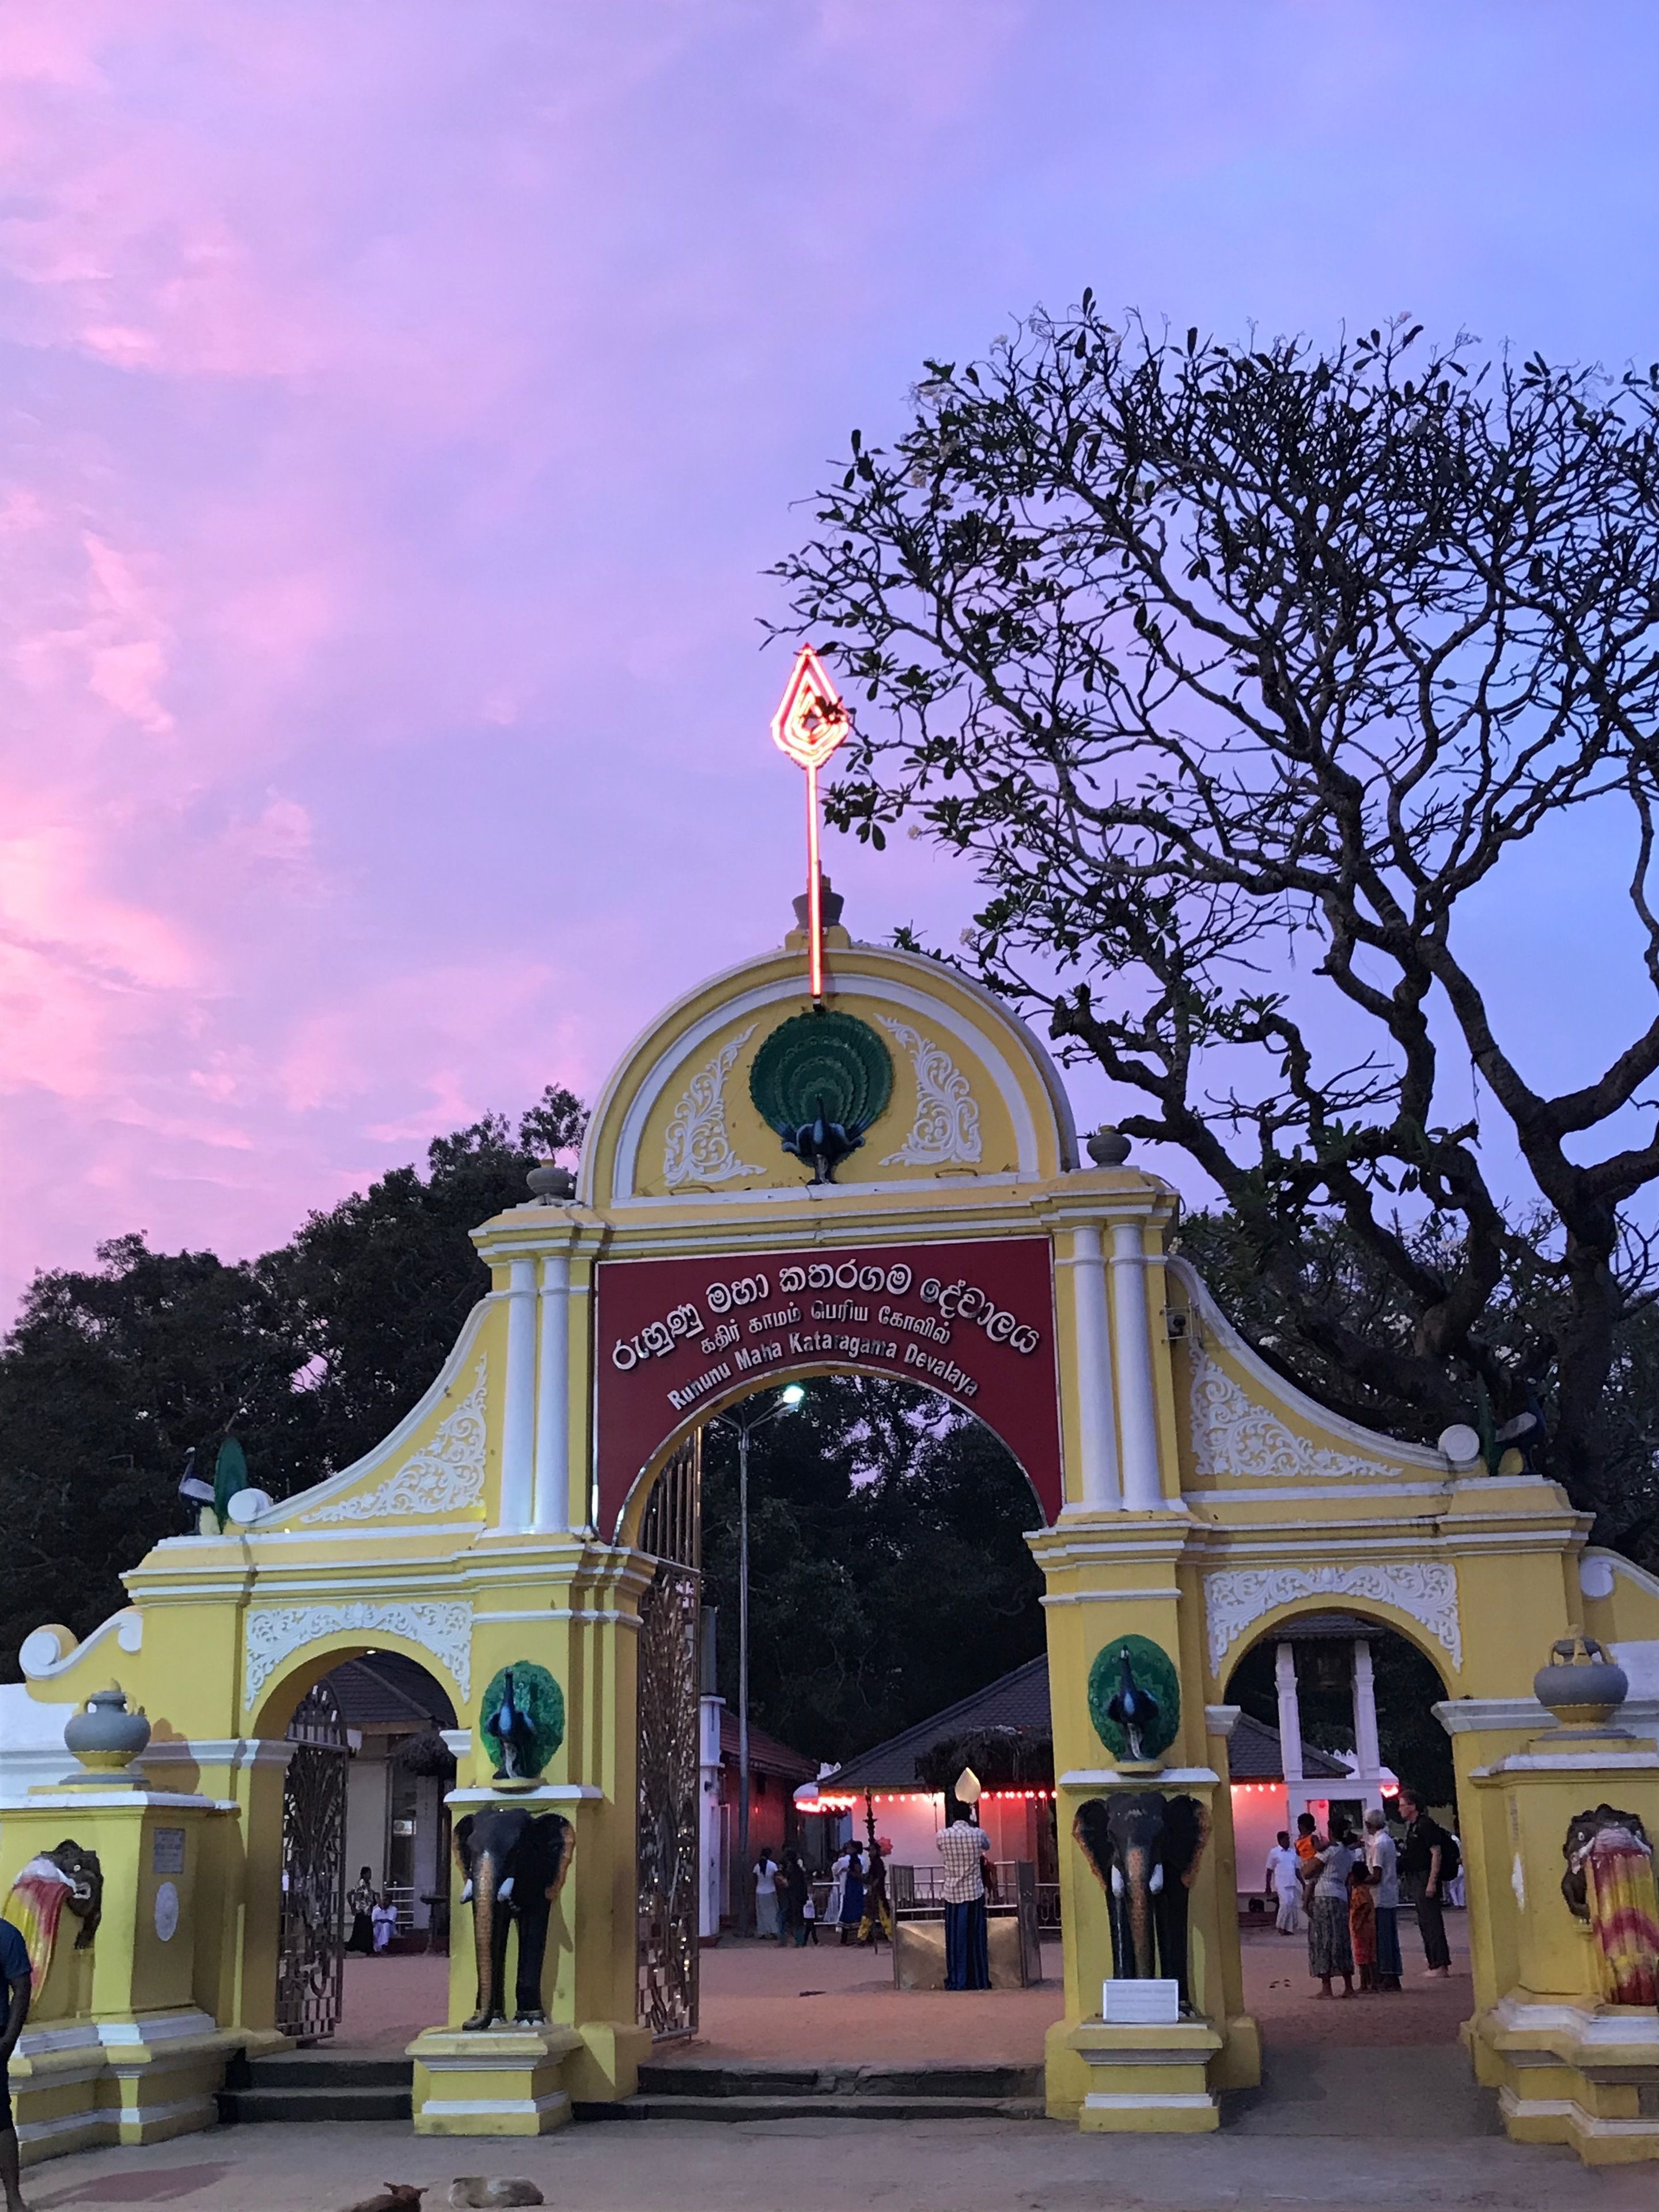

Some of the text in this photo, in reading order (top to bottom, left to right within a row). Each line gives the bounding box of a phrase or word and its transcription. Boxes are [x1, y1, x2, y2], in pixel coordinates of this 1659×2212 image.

[612, 1258, 1040, 1370] රුහුණු මහා කතරගම දේවාලය
[700, 1298, 950, 1352] கதிர் காமம் பெரிய கோவில்
[733, 1339, 783, 1371] Maha
[788, 1331, 897, 1358] Kataragama
[903, 1343, 979, 1396] Devalaya
